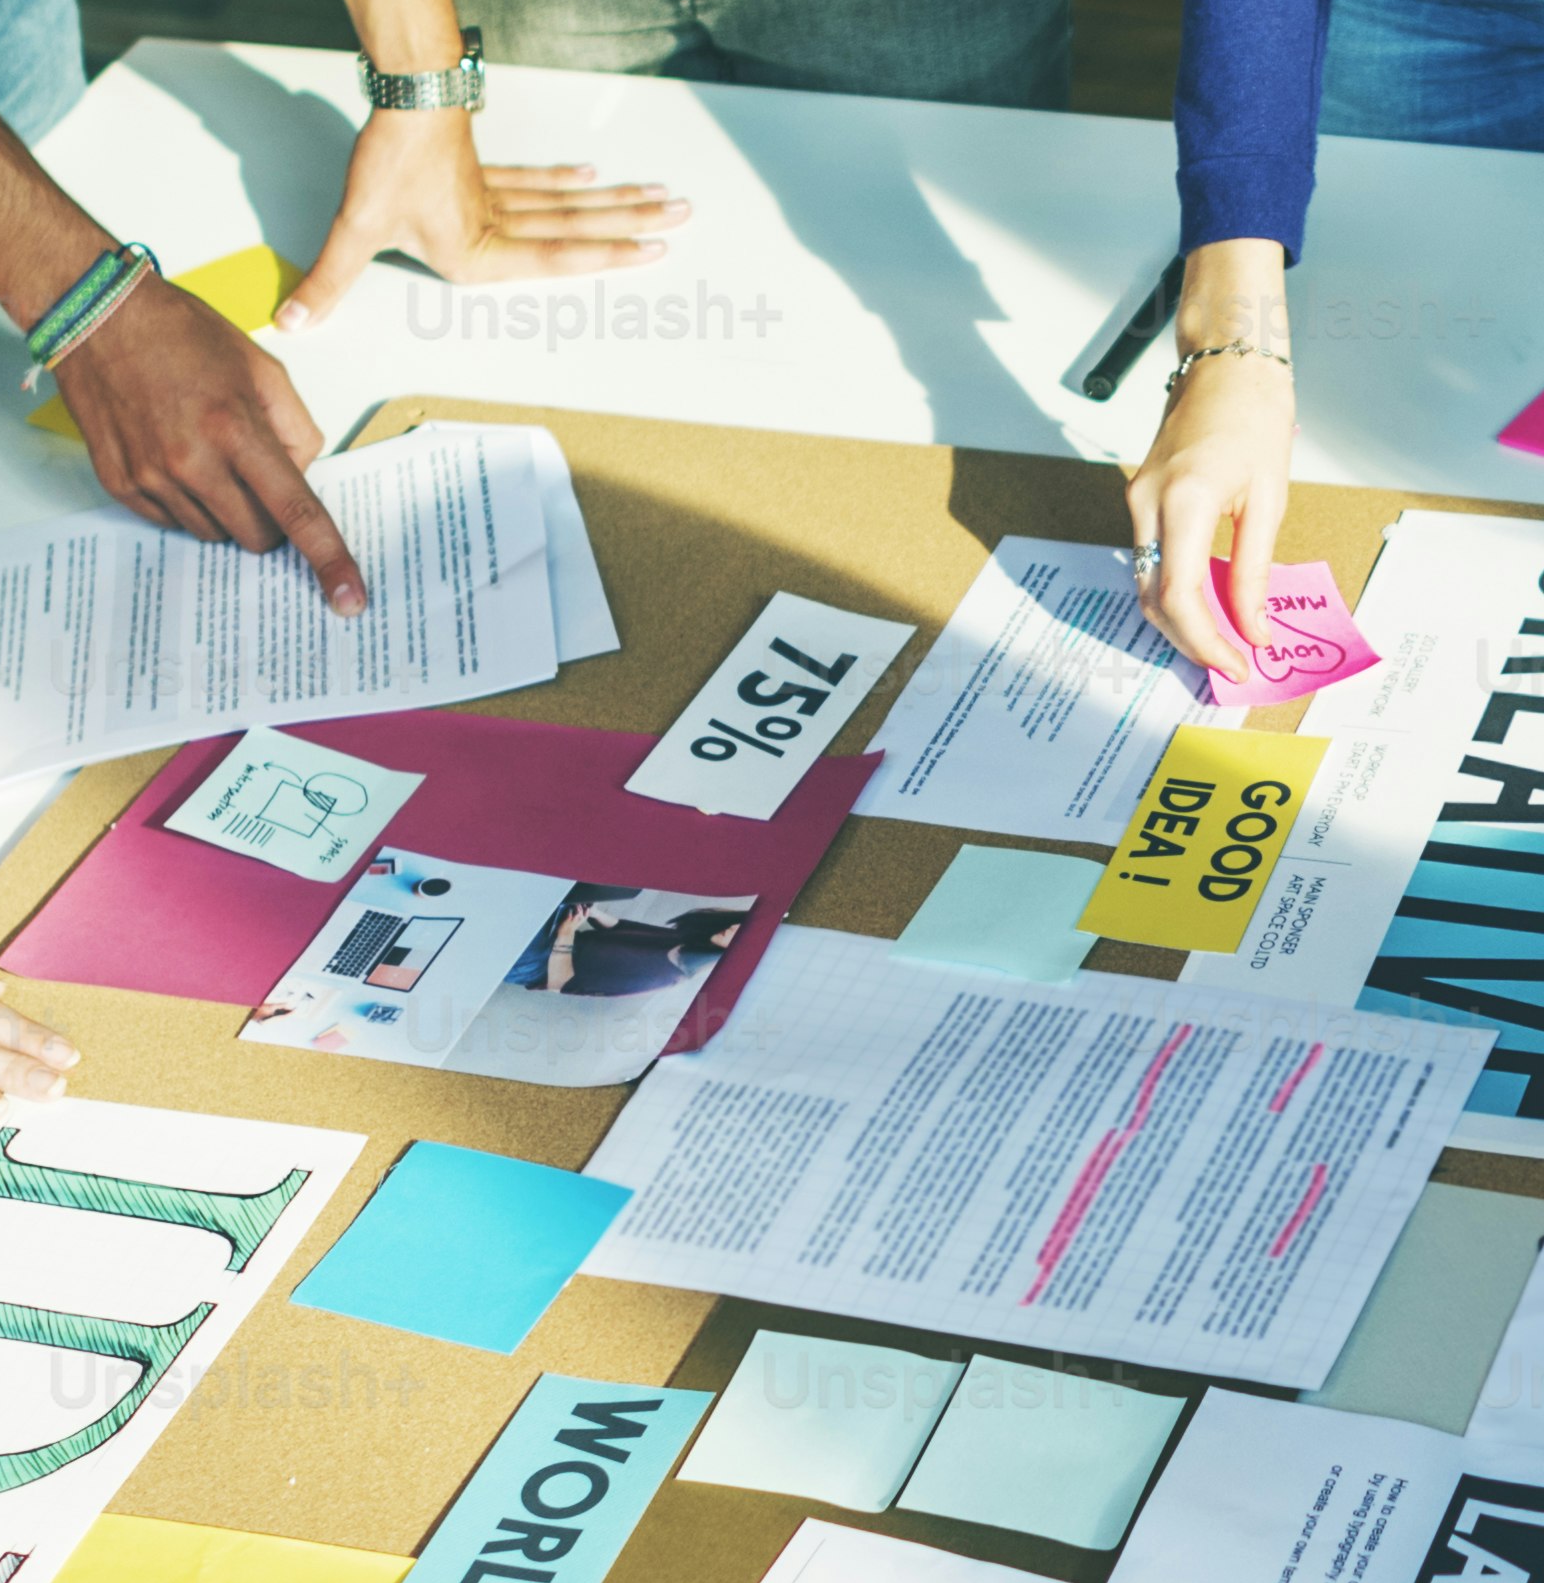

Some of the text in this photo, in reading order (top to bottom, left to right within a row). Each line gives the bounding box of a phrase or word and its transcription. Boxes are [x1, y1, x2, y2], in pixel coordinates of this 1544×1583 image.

[1265, 644, 1326, 662] LOVE
[1396, 633, 1419, 656] EAST
[1403, 634, 1439, 693] 203 GALLERY
[690, 637, 858, 761] 75%
[1345, 742, 1367, 768] START
[1353, 744, 1388, 801] WORKSHOP
[1331, 781, 1351, 796] PM
[1129, 778, 1216, 858] IDEA
[1306, 797, 1345, 847] EVERYDAY
[1198, 780, 1291, 902] GOOD
[1283, 875, 1304, 896] ART
[1268, 897, 1296, 930] SPACE
[1279, 877, 1327, 955] MAIN SPONSER
[1329, 1465, 1344, 1477] or
[1368, 1472, 1388, 1487] by
[1313, 1478, 1338, 1512] create
[1351, 1489, 1378, 1519] using
[1386, 1478, 1409, 1502] How
[1381, 1505, 1397, 1515] to
[1297, 1514, 1322, 1539] your
[1365, 1518, 1391, 1552] create
[1289, 1540, 1308, 1564] own
[1323, 1520, 1365, 1581] typography
[1350, 1554, 1375, 1579] your
